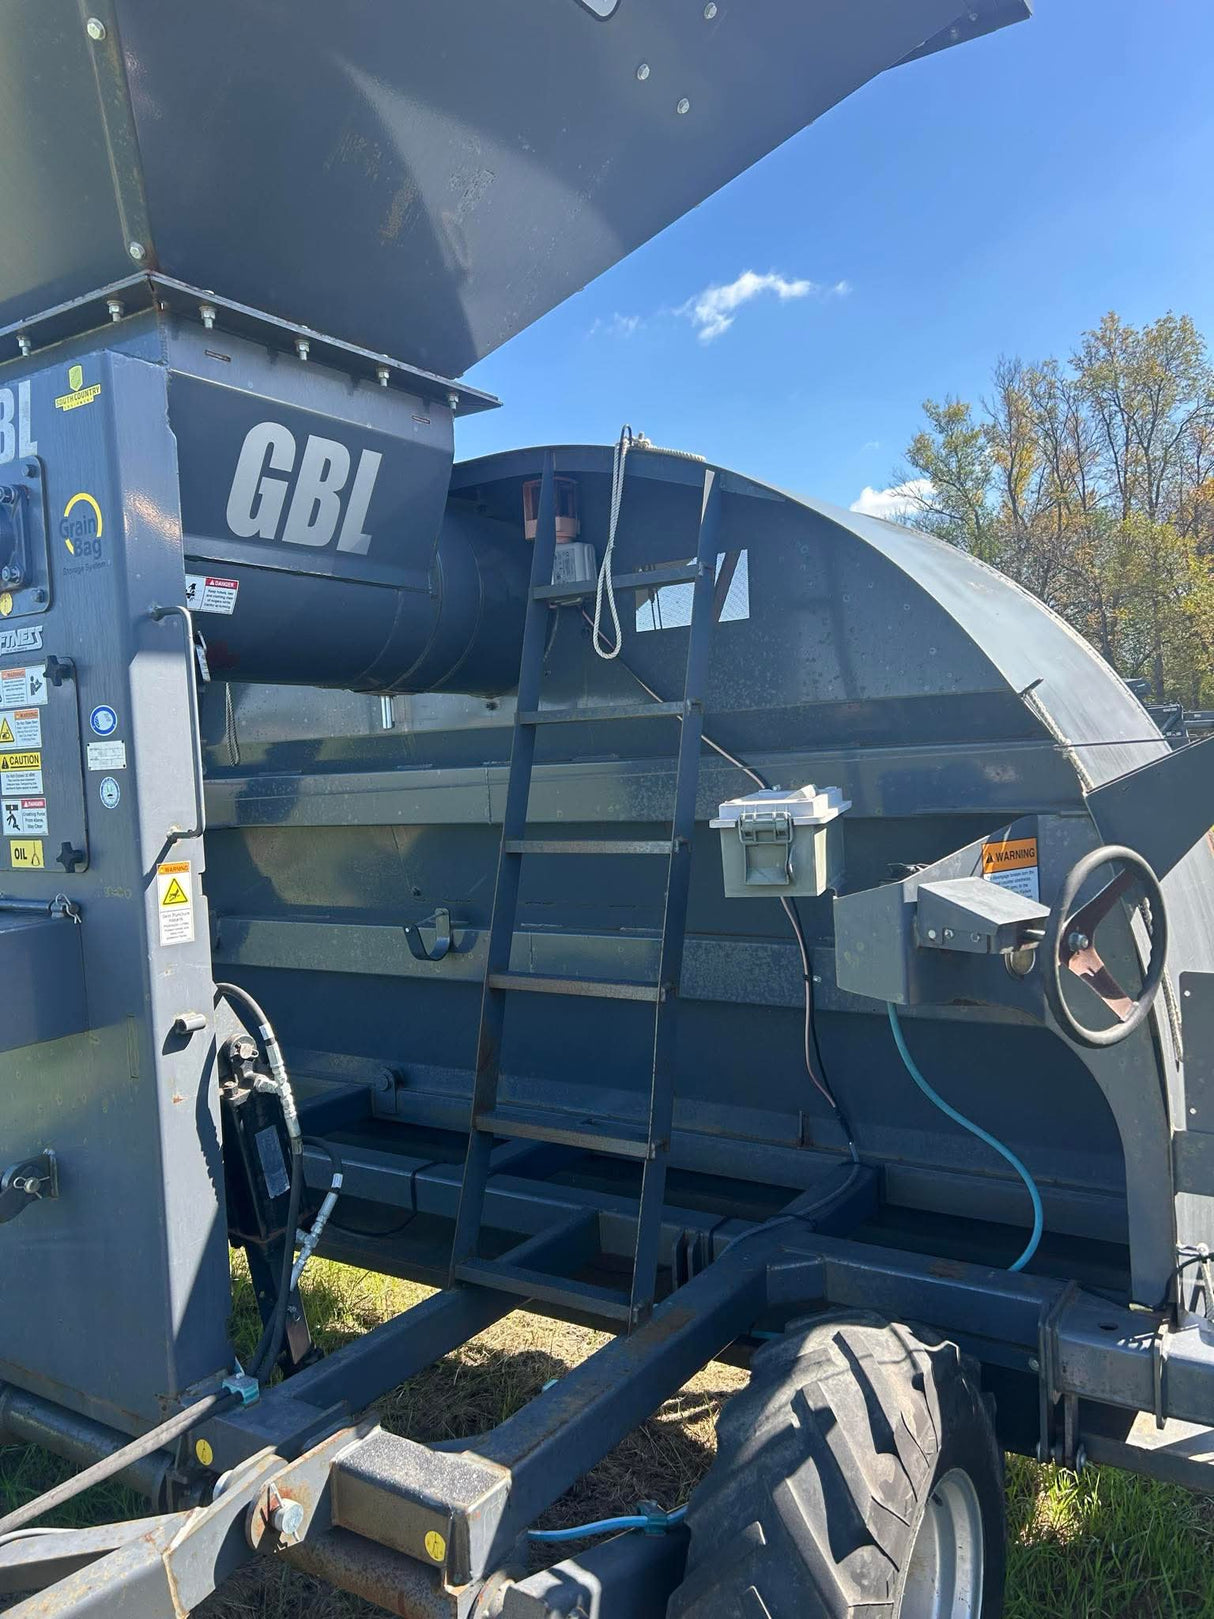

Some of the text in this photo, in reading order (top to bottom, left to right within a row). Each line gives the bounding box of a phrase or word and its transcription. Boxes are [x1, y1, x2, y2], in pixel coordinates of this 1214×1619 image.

[226, 422, 382, 556] GBL
[60, 515, 96, 538] Grain
[74, 538, 102, 560] Bag
[10, 755, 39, 765] CAUTION
[14, 848, 27, 860] OIL
[996, 848, 1035, 862] WARNING
